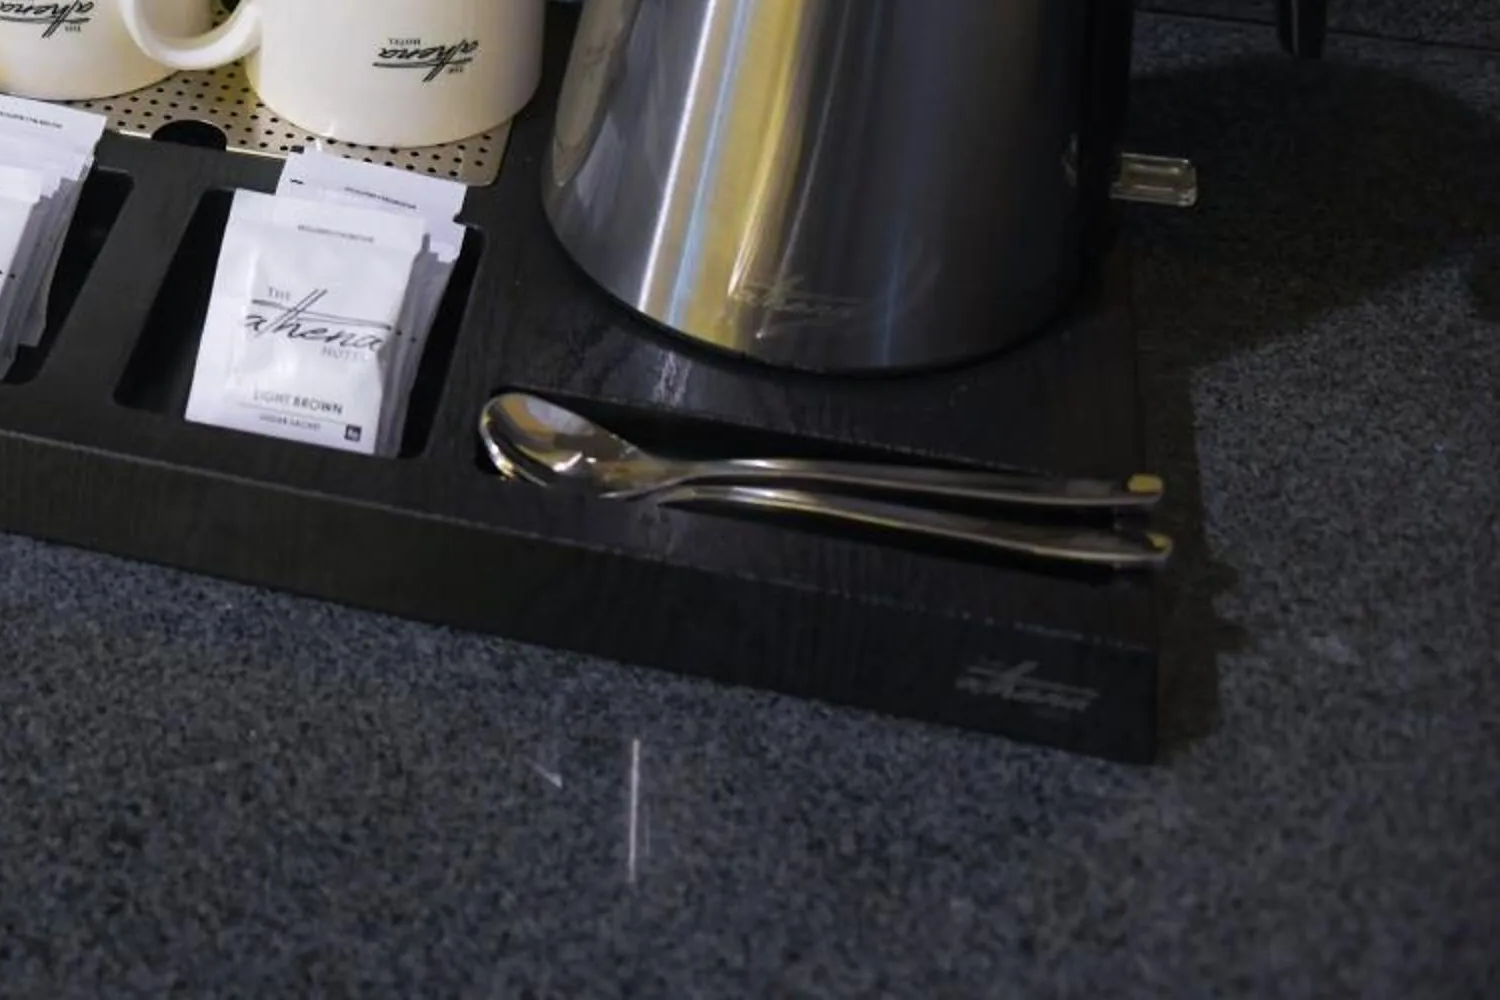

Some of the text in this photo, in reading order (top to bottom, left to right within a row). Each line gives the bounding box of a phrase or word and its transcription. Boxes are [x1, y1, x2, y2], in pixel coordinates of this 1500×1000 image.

[371, 39, 479, 83] athena
[243, 288, 393, 352] athena
[253, 388, 344, 415] LIGHT BROWN
